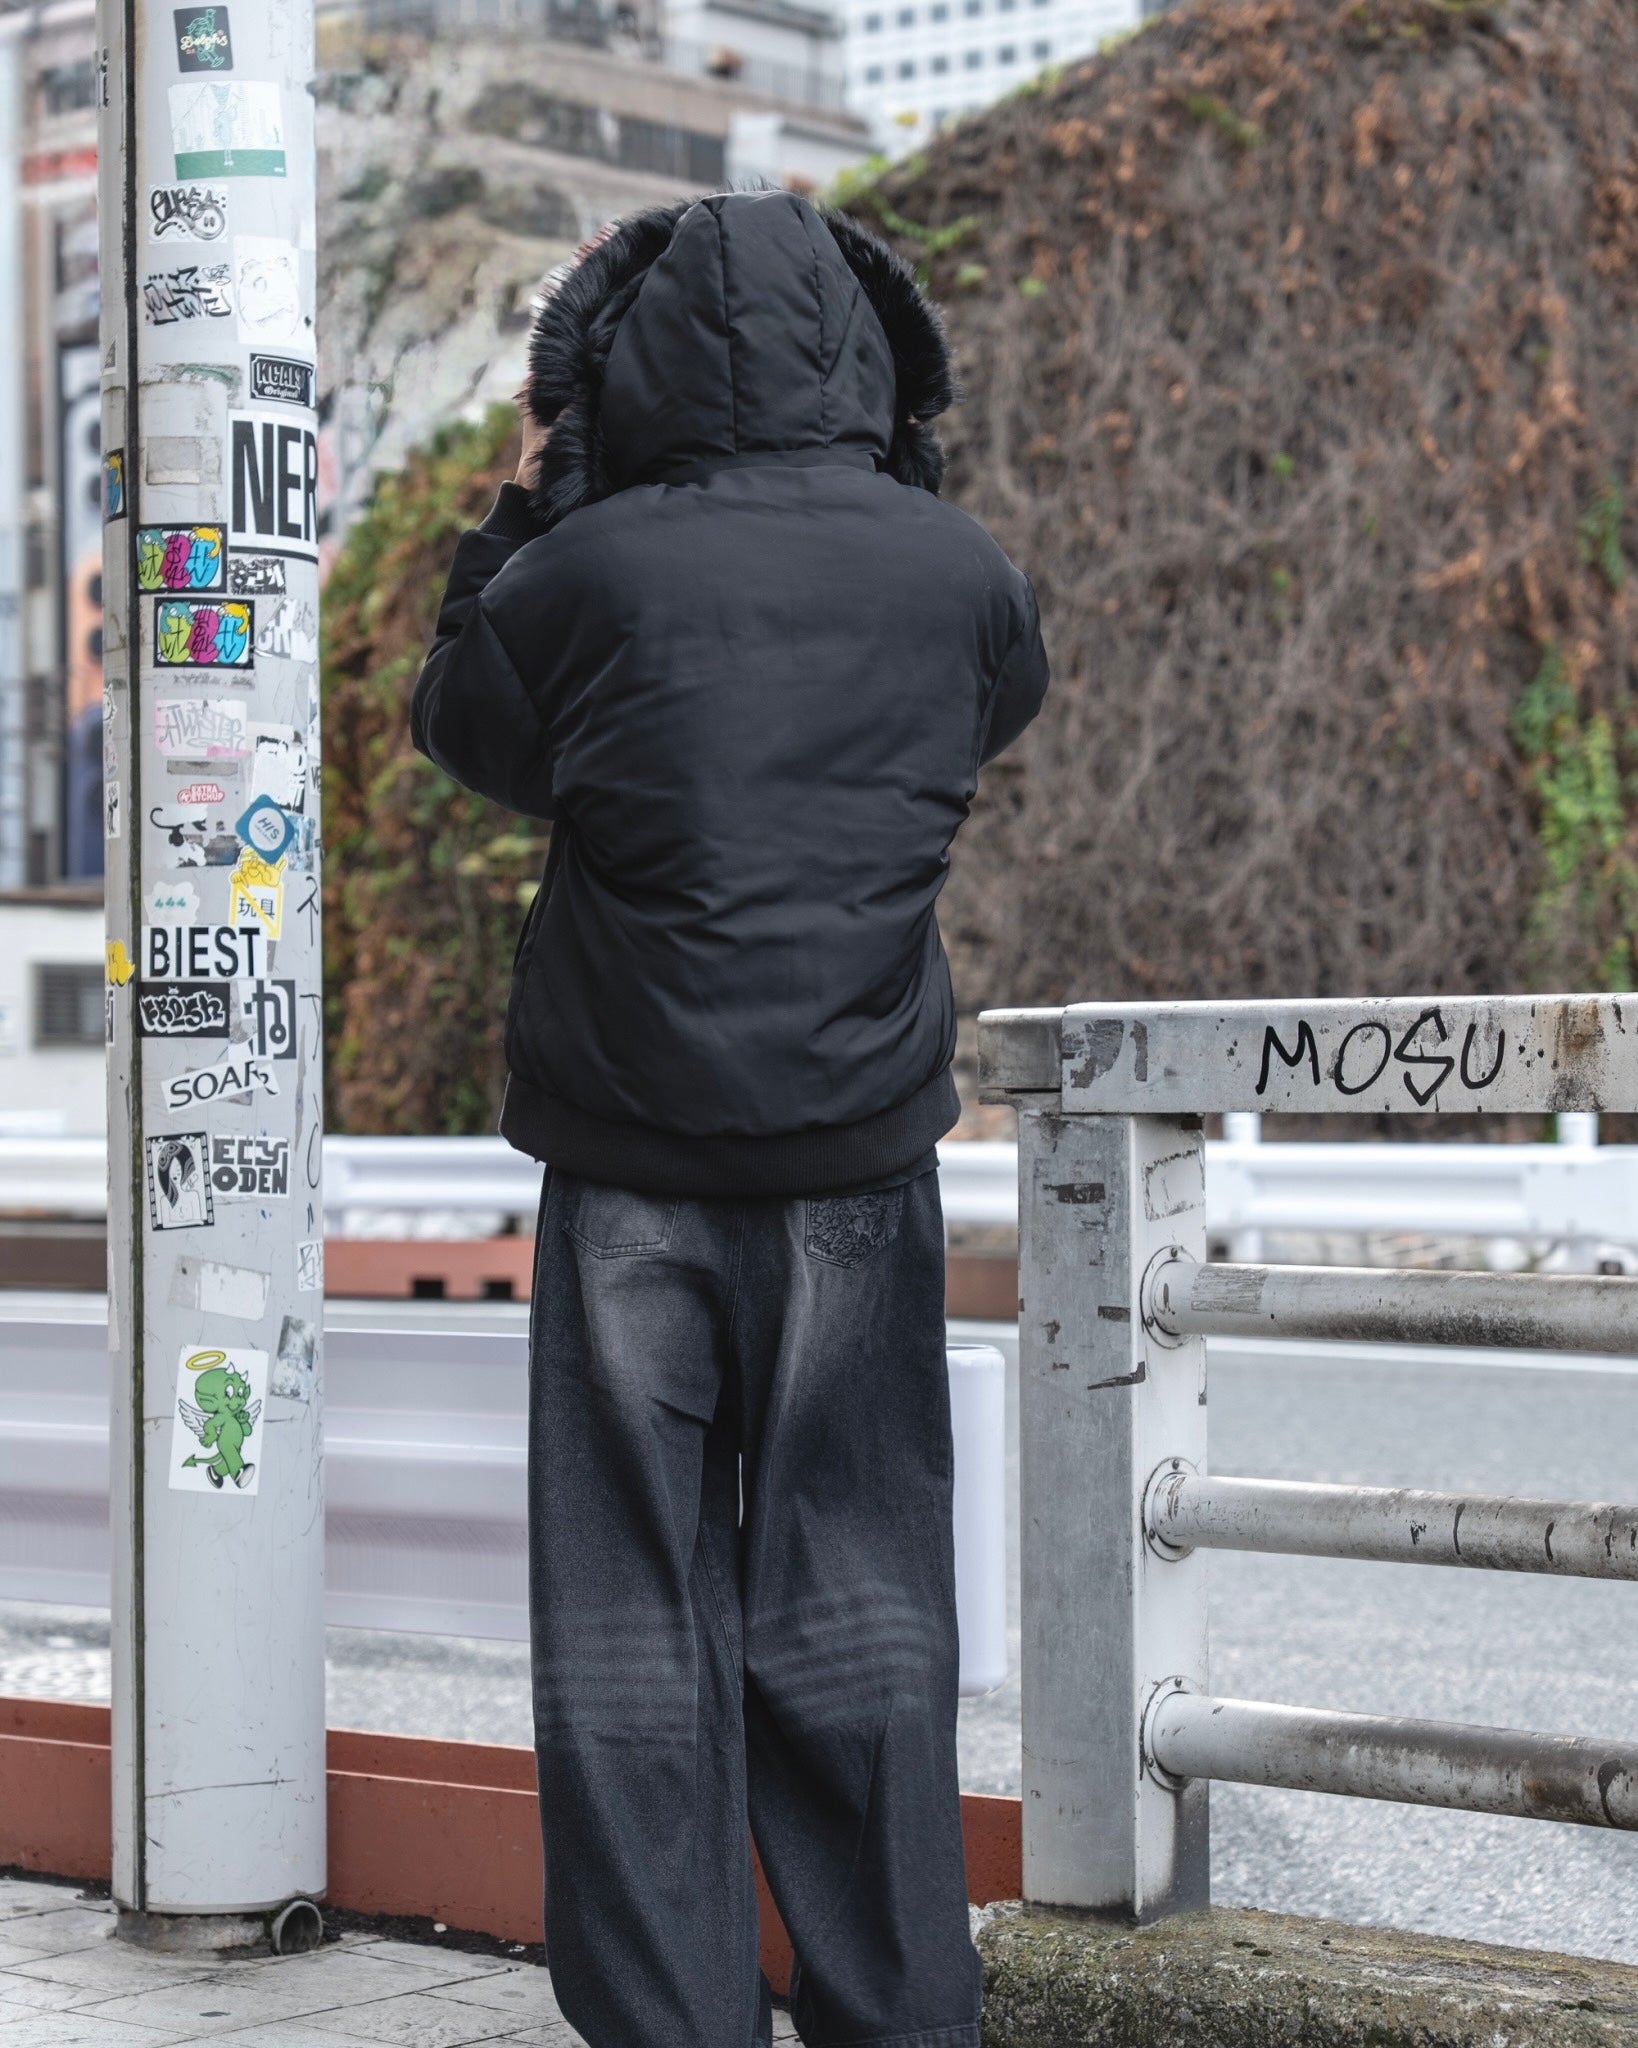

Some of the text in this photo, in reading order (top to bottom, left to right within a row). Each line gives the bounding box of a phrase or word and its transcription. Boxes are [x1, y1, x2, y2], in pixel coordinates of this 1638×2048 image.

[258, 817, 280, 840] HIS
[150, 926, 260, 977] BIEST
[1255, 1008, 1505, 1106] MOSU
